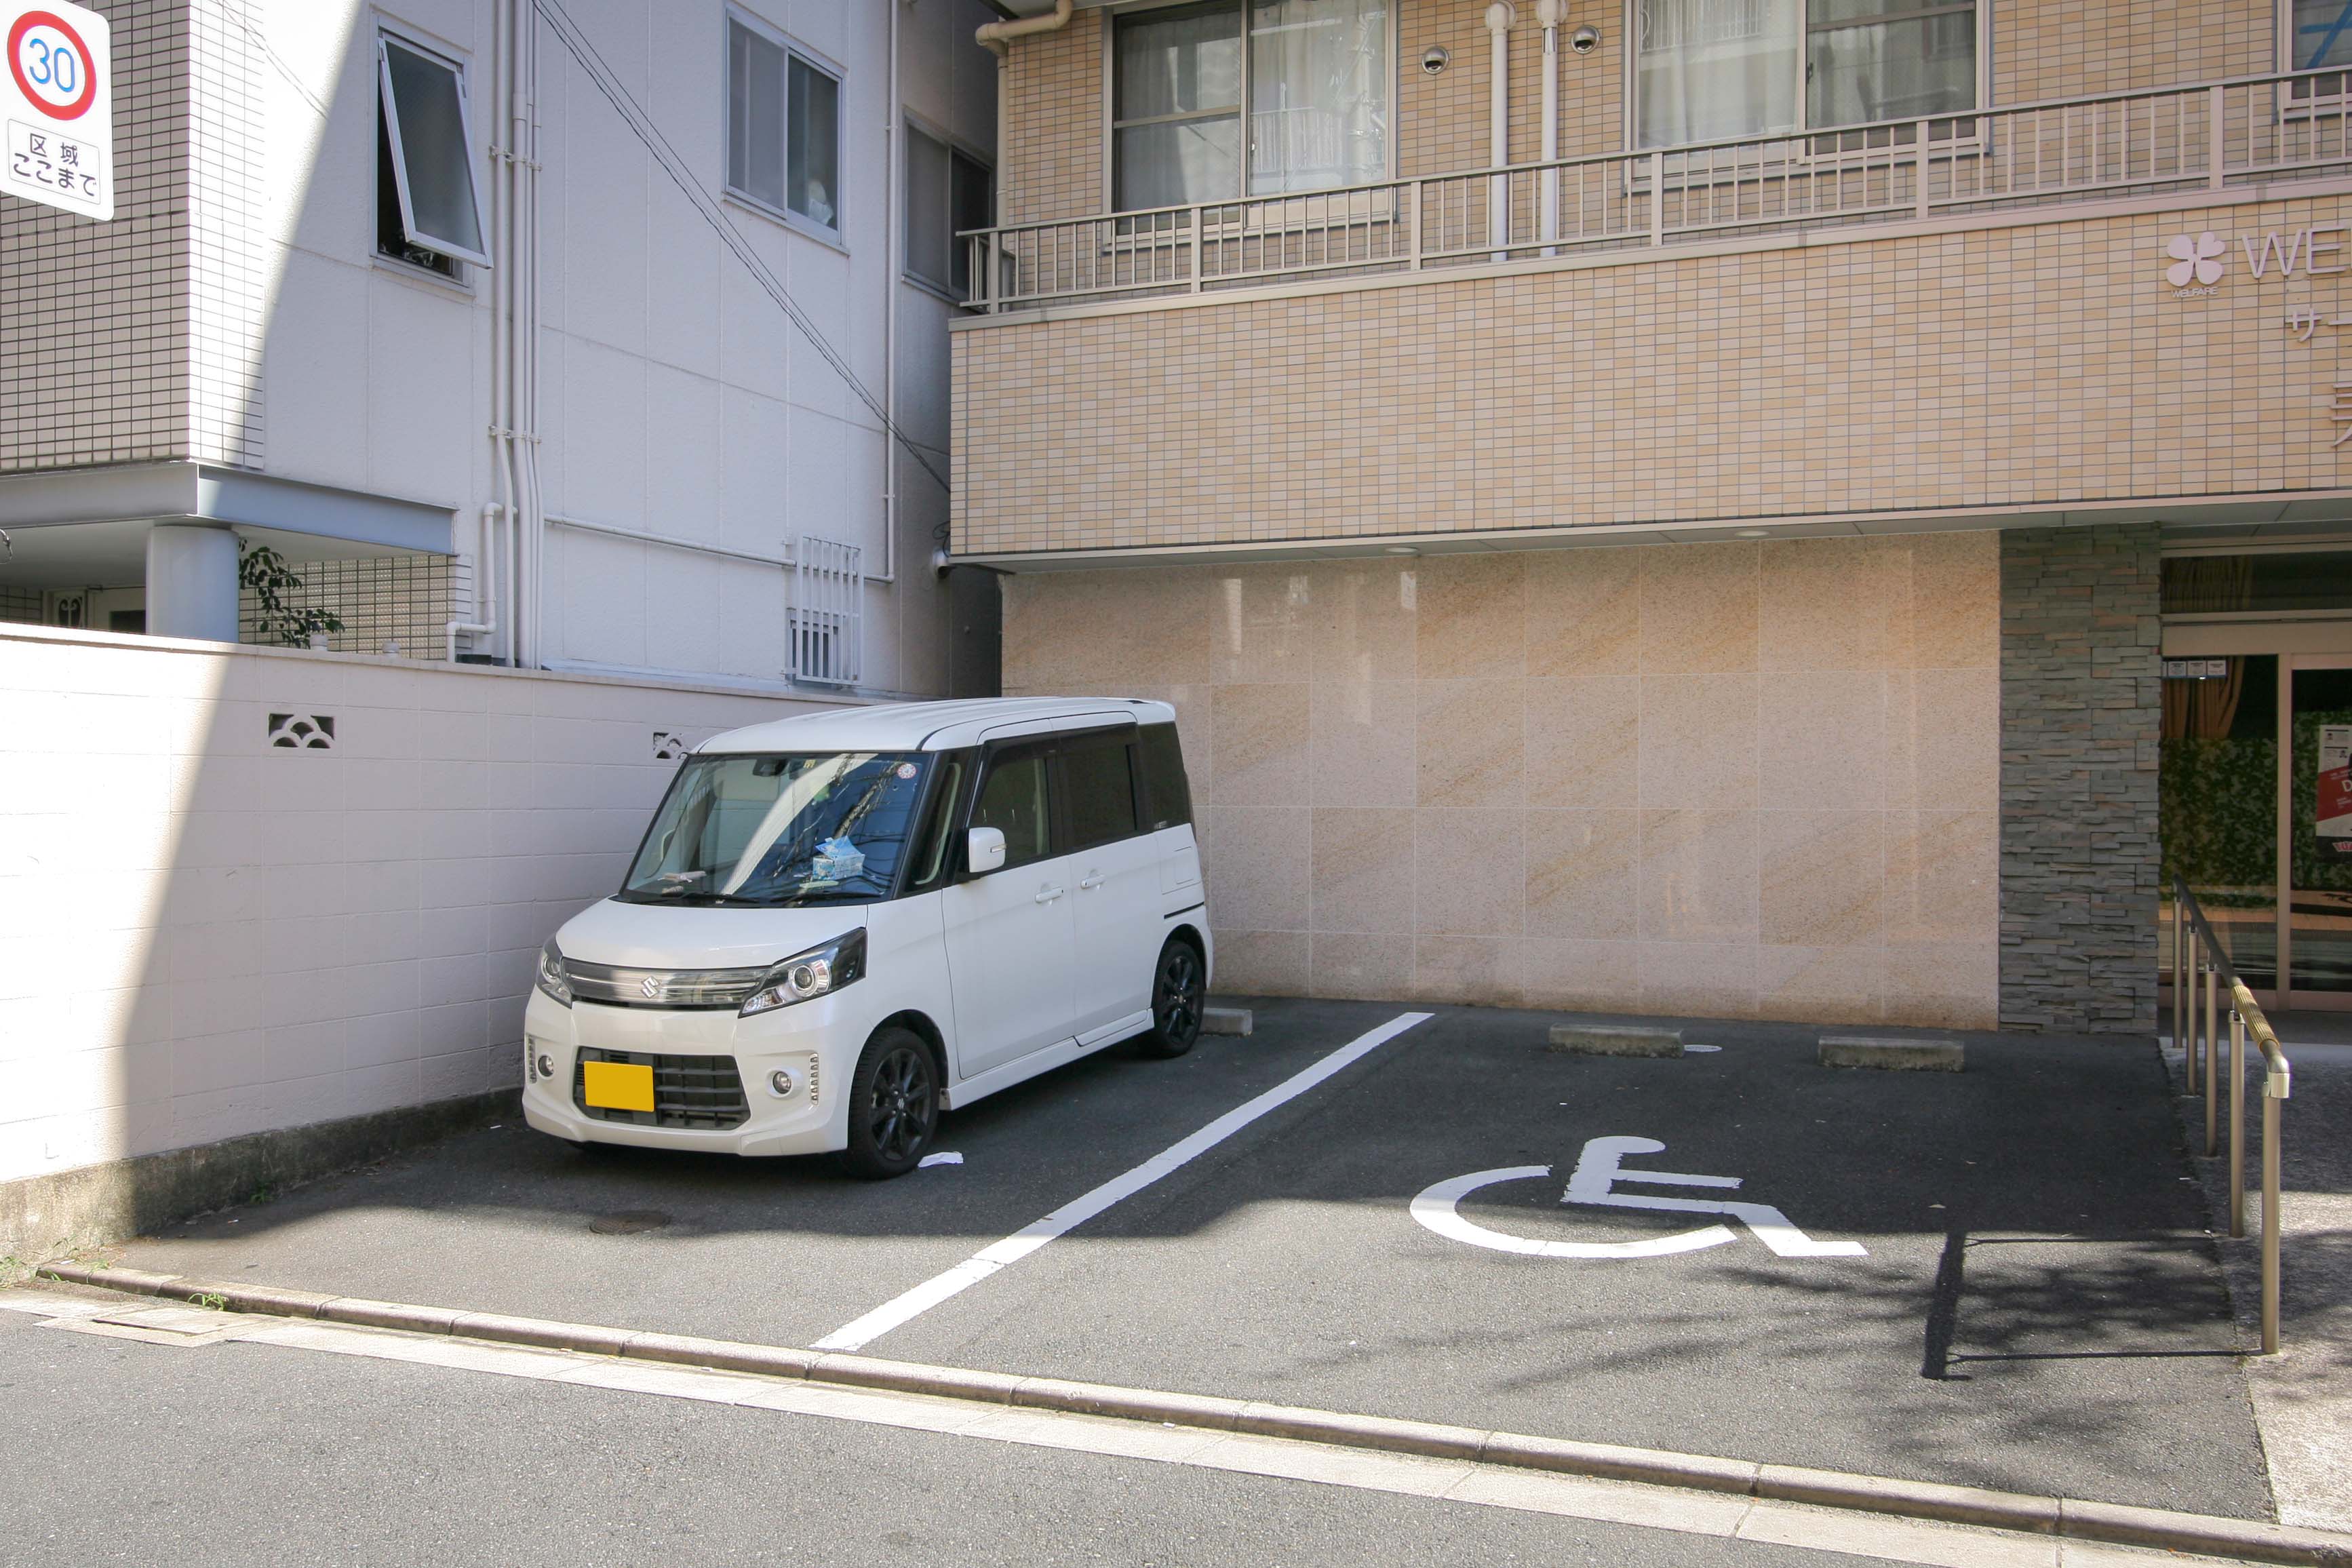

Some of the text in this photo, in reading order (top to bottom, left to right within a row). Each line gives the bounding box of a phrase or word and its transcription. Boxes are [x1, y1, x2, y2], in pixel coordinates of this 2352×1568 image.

[29, 38, 76, 92] 30
[30, 133, 79, 167] 区域
[14, 153, 97, 197] ここまで
[2241, 226, 2352, 279] WE
[2170, 286, 2220, 298] WELFARE
